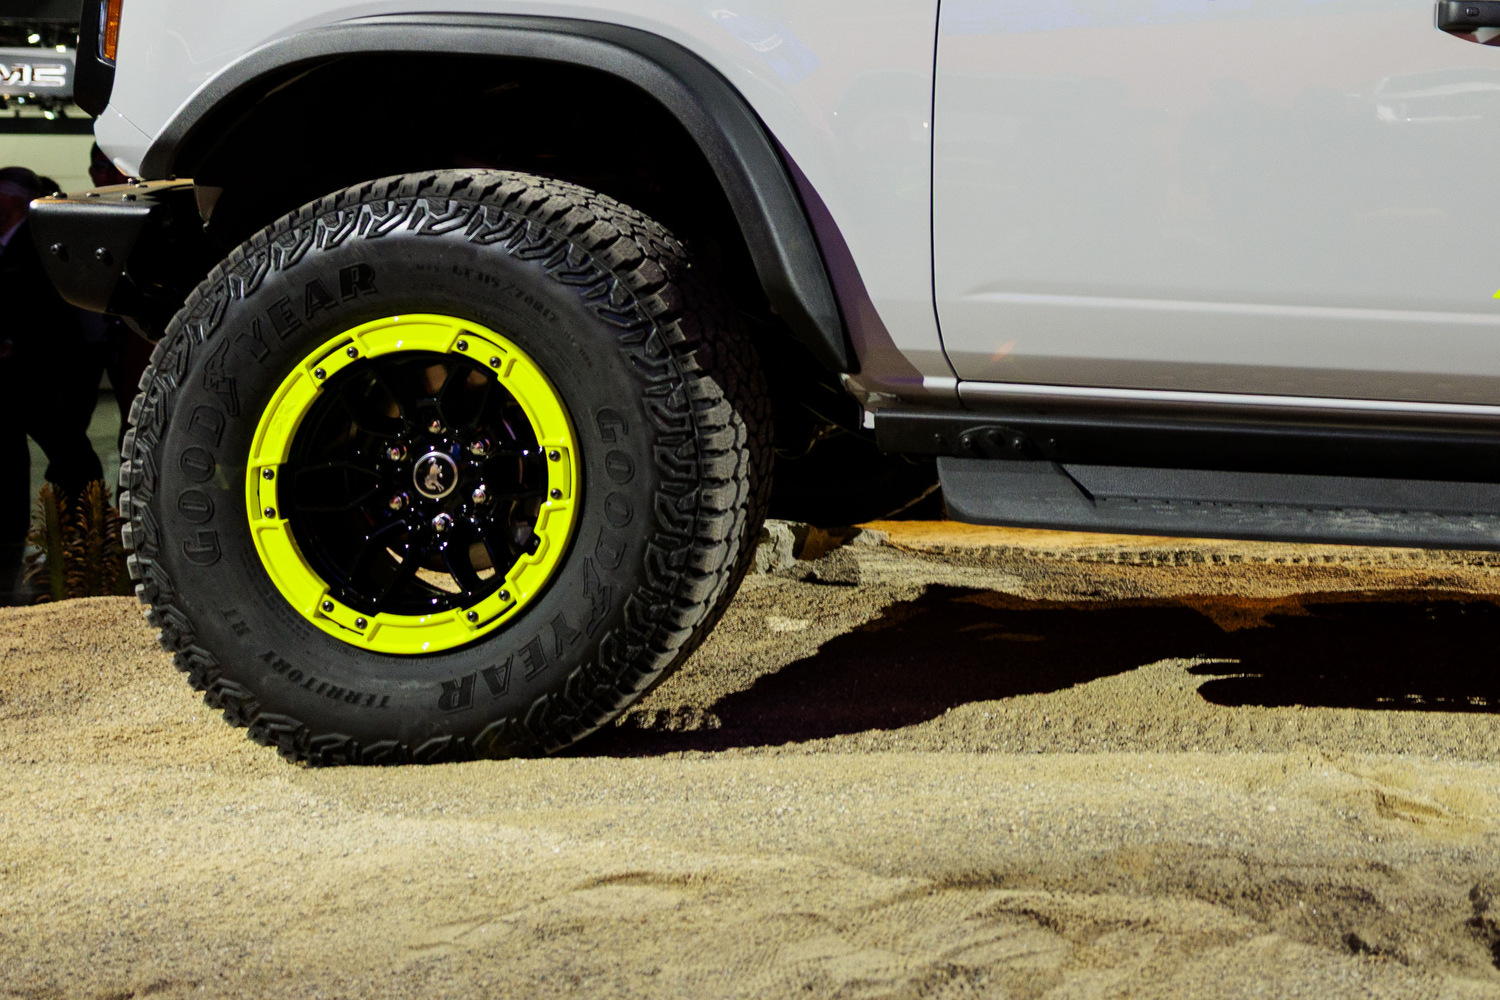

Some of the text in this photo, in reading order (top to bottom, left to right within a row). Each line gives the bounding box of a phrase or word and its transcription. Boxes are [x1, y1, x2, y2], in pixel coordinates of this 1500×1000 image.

[231, 260, 381, 363] YEAR
[177, 404, 228, 568] GOOD
[258, 650, 392, 709] TERRITORY
